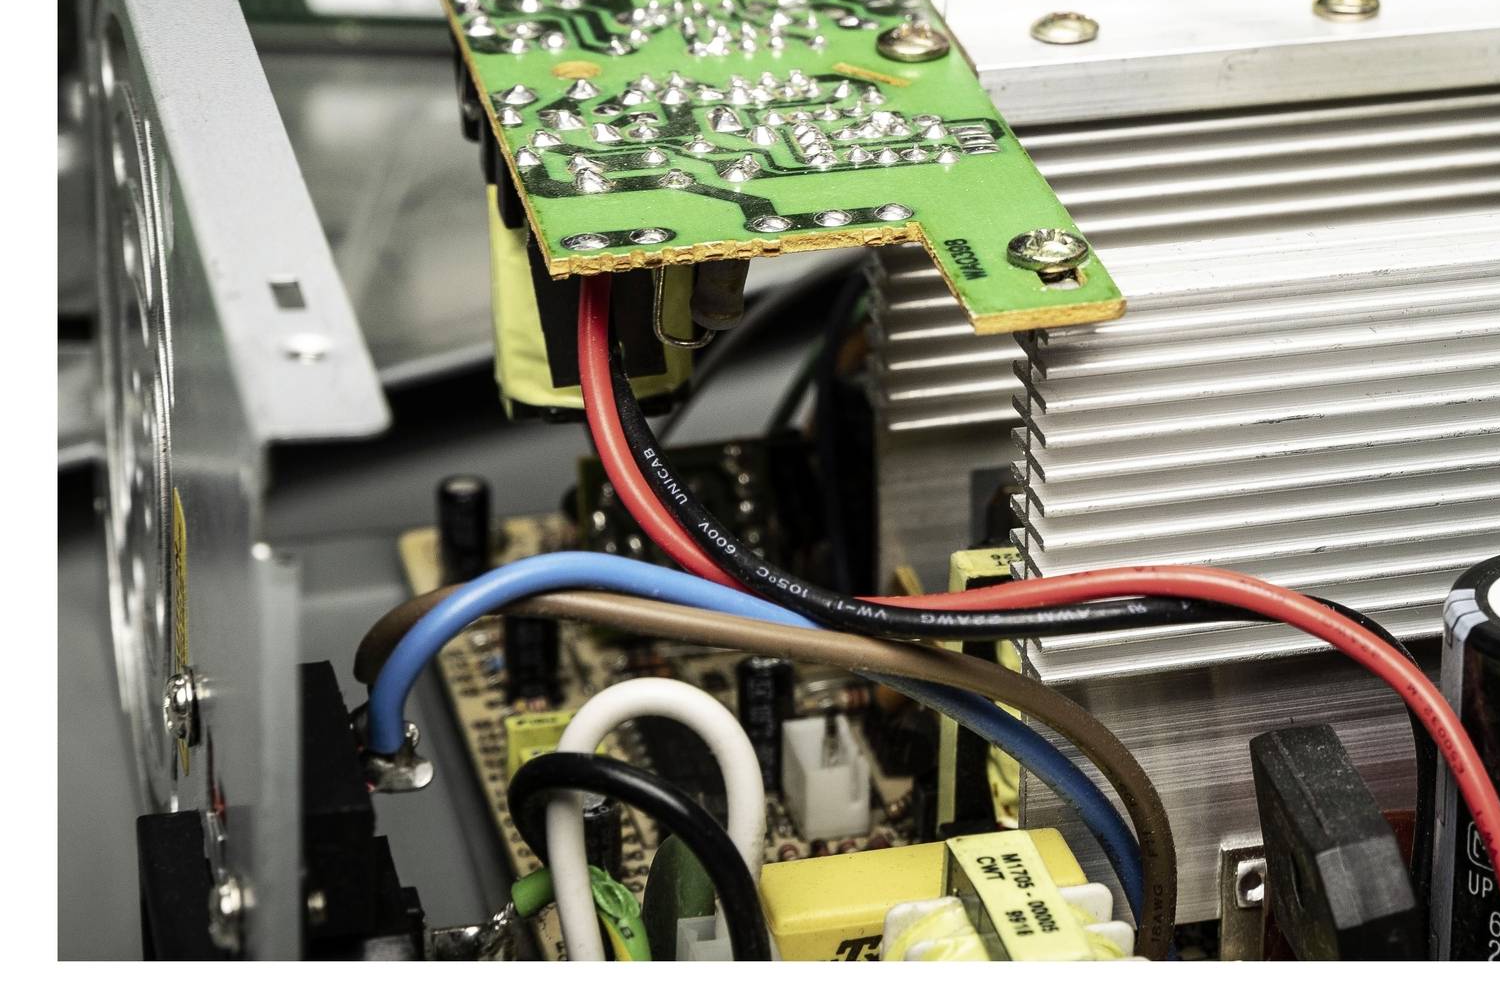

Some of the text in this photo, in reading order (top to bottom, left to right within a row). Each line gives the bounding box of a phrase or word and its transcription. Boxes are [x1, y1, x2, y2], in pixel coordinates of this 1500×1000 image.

[643, 447, 688, 505] UNICAB
[698, 521, 736, 555] 600V
[976, 856, 1005, 881] CWT
[1001, 853, 1035, 889] M1705
